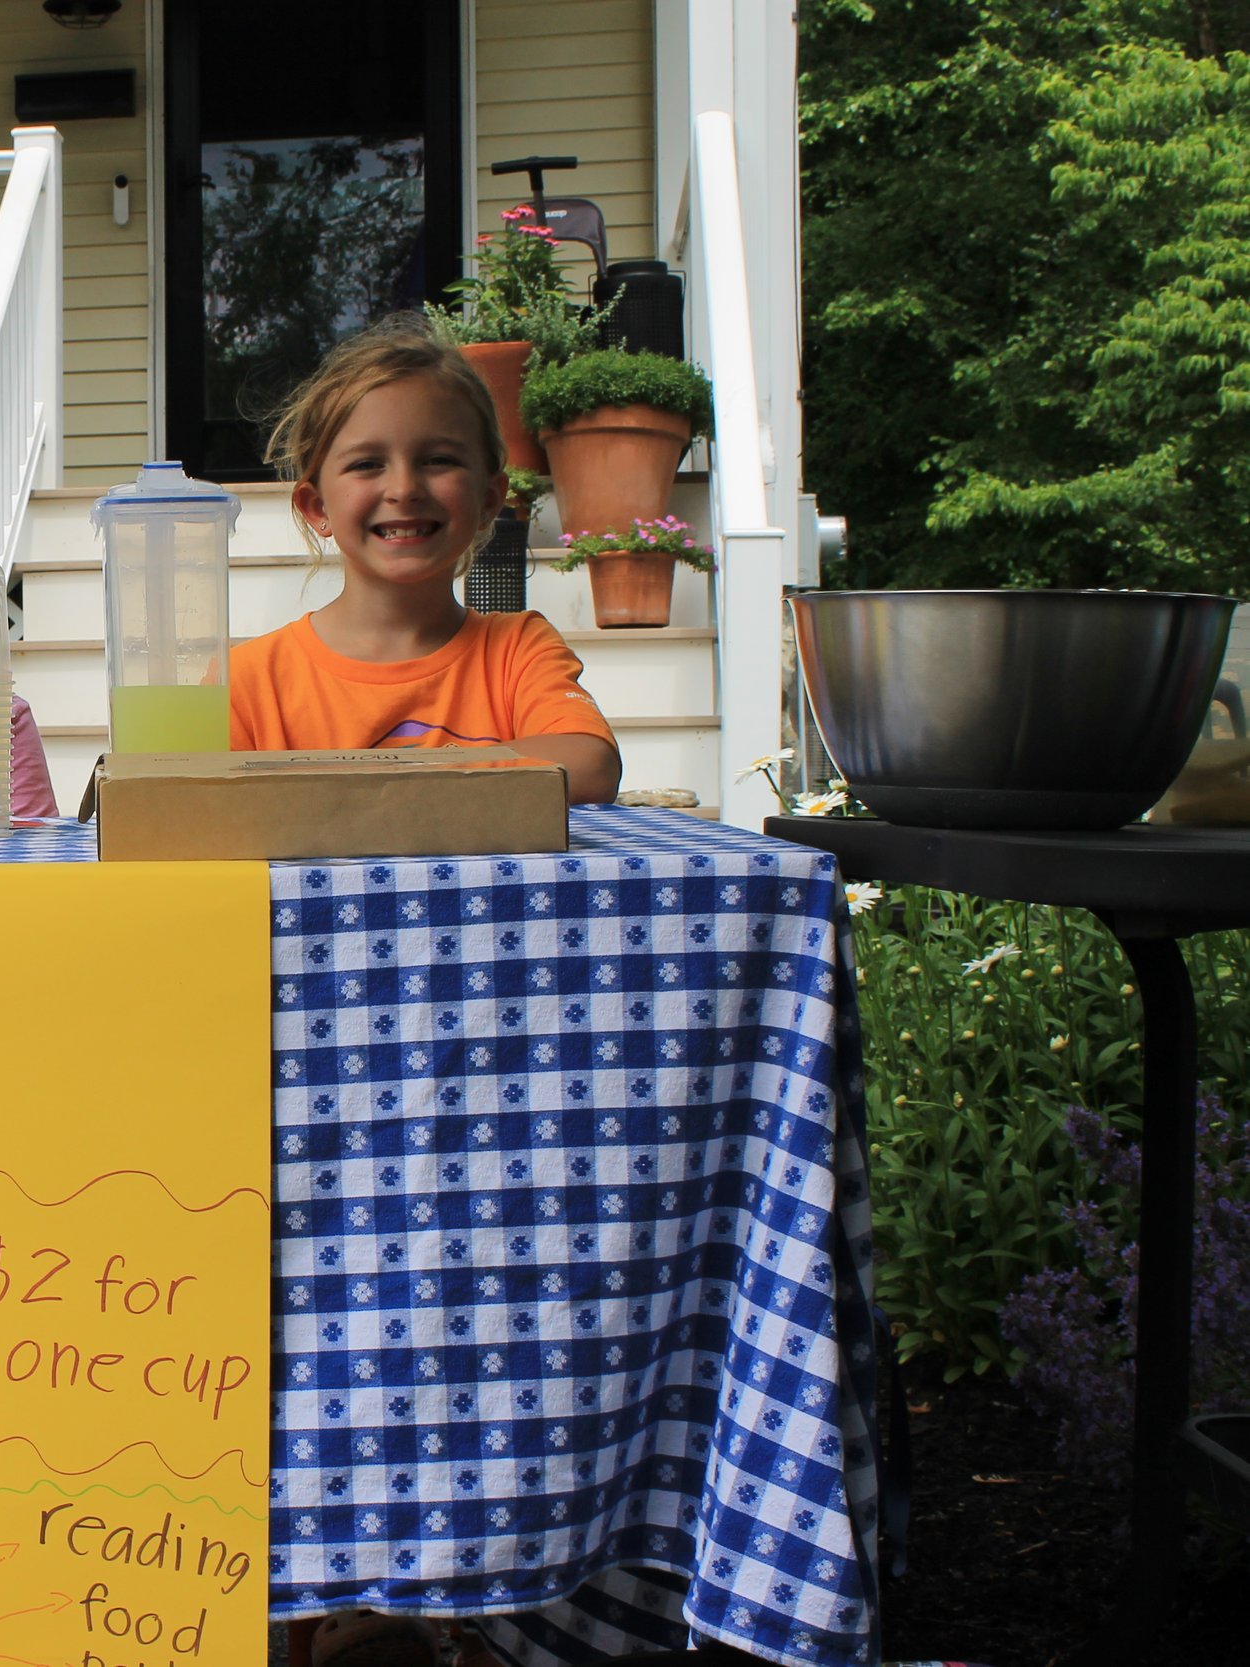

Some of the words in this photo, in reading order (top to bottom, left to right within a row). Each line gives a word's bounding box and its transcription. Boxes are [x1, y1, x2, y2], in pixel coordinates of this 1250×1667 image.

[95, 1254, 198, 1315] for
[6, 1339, 124, 1393] one
[143, 1353, 251, 1420] cup
[38, 1502, 251, 1595] reading
[80, 1582, 208, 1657] food
